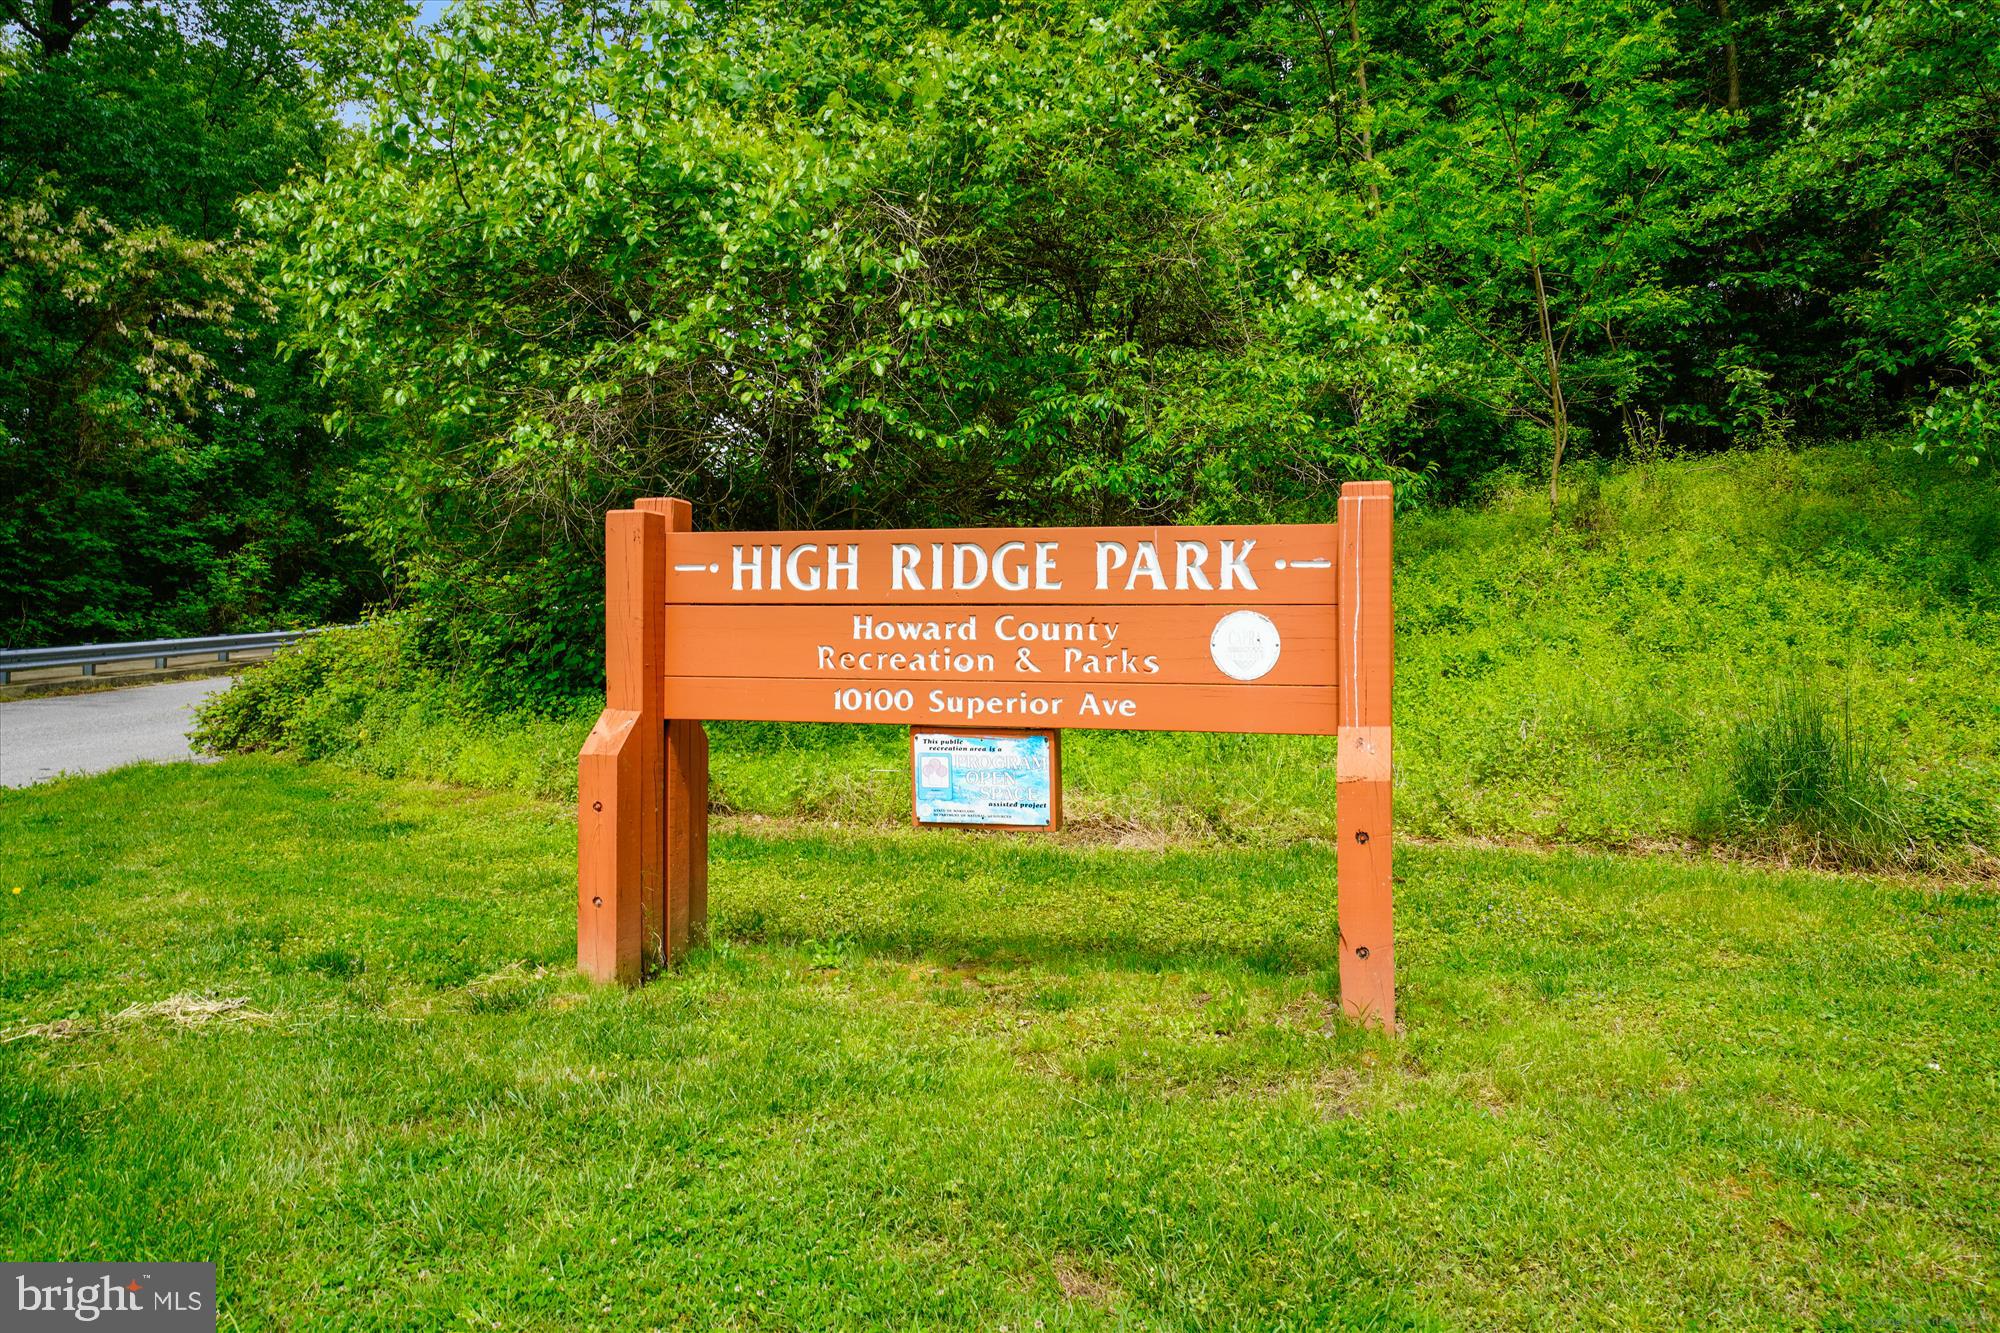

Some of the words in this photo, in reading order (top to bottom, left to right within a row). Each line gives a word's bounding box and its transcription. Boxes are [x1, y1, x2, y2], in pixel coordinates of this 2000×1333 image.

[731, 544, 859, 592] HIGH
[891, 541, 1063, 592] RIDGE
[1094, 539, 1260, 591] PARK
[852, 615, 978, 641] Howard
[994, 615, 1120, 648] County
[817, 645, 995, 673] Recreation
[1015, 648, 1042, 673] &
[1064, 646, 1161, 675] Parks
[833, 687, 914, 713] 10100
[928, 689, 1064, 720] Superior
[1078, 691, 1138, 717] Ave
[940, 738, 964, 746] public
[953, 754, 1047, 771] PROGRAM
[965, 770, 1017, 786] OPEN
[979, 786, 1040, 801] SPACE
